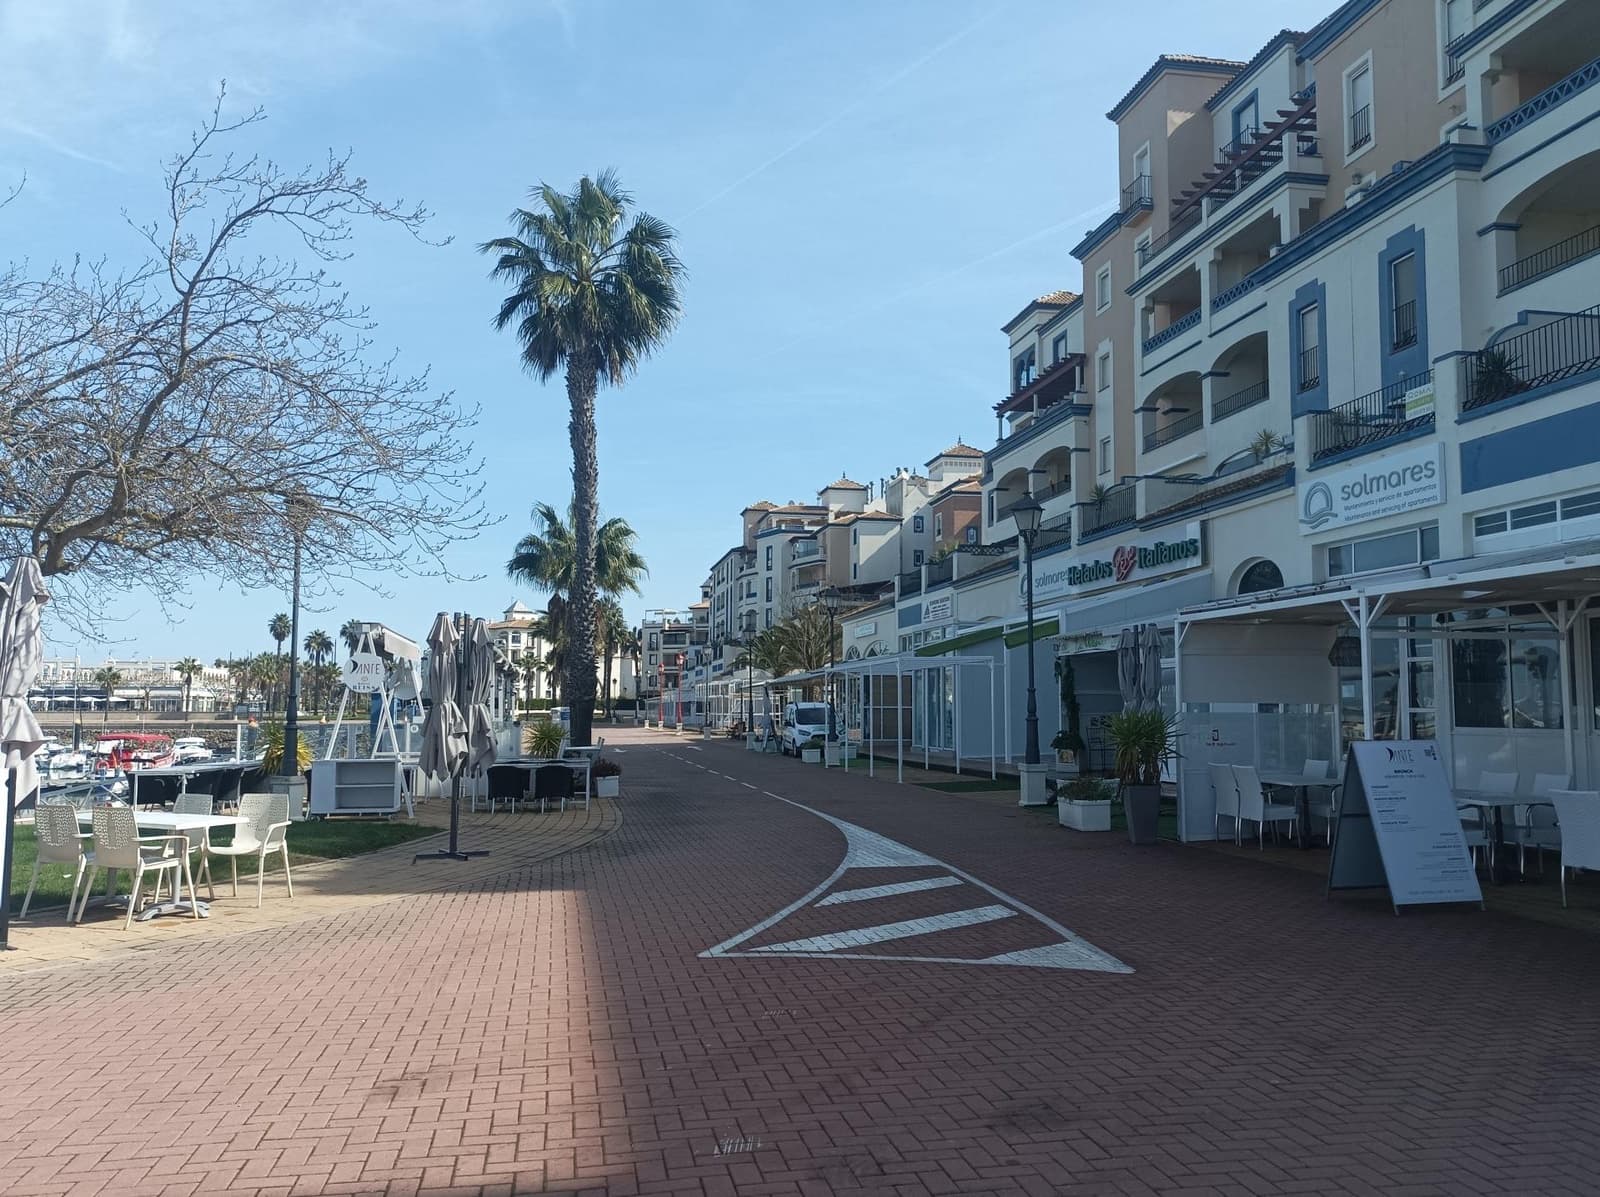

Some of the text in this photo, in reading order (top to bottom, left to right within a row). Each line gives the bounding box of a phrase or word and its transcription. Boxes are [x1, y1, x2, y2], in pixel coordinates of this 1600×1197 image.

[1341, 460, 1436, 501] solmares
[1067, 559, 1113, 586] Helados
[1138, 538, 1198, 569] Italianos
[350, 659, 381, 675] DANTE
